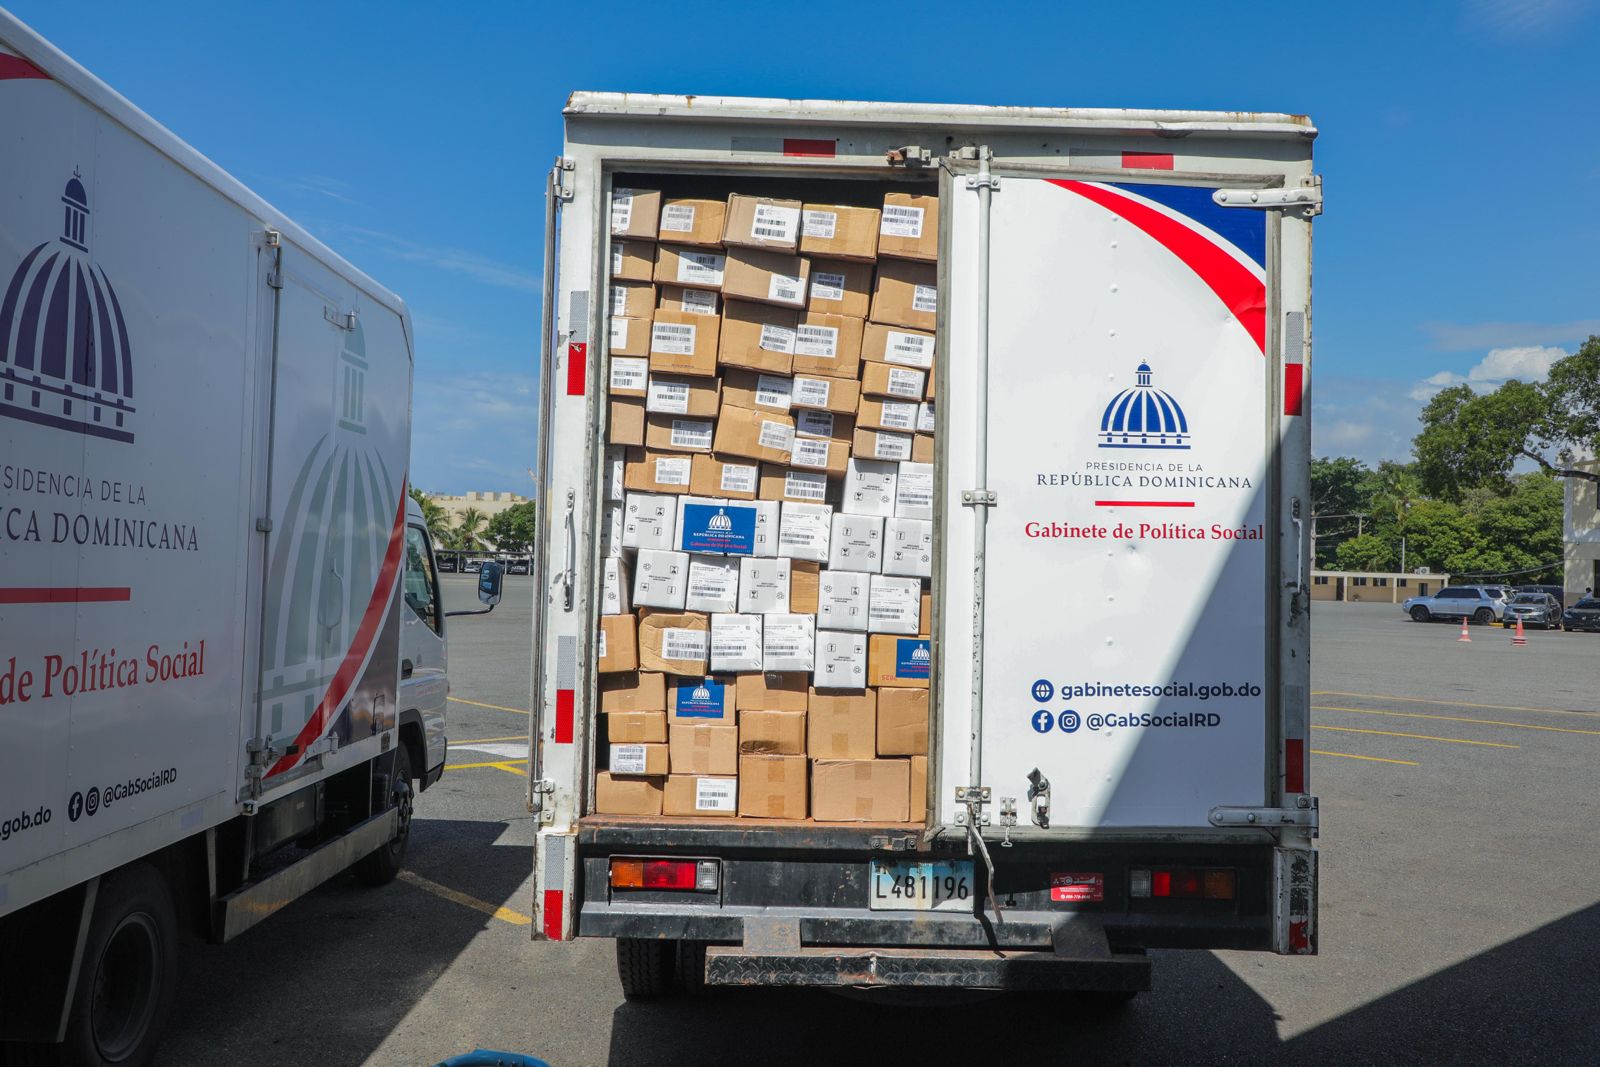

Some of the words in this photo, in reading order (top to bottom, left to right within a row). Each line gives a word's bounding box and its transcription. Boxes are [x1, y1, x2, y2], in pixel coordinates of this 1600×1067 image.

[1086, 462, 1164, 472] PRESIDENCIA
[1168, 463, 1184, 472] DE
[1188, 463, 1203, 472] LA
[0, 465, 93, 499] SIDENCIA
[101, 480, 122, 503] DE
[128, 484, 146, 505] LA
[1037, 472, 1132, 487] REPÚBLICA
[1139, 475, 1252, 488] DOMINICANA
[51, 512, 199, 551] DOMINICANA
[1025, 522, 1107, 538] Gabinete
[1112, 523, 1133, 539] de
[1139, 522, 1206, 539] Política
[1211, 524, 1264, 540] Social
[0, 656, 33, 705] de
[41, 648, 139, 698] Política
[145, 640, 205, 684] Social
[1061, 682, 1261, 700] gabinetesocial.gob.do
[1086, 712, 1221, 731] @GabSocialRD
[102, 767, 177, 808] @GabSocialRD
[876, 874, 968, 900] L481196
